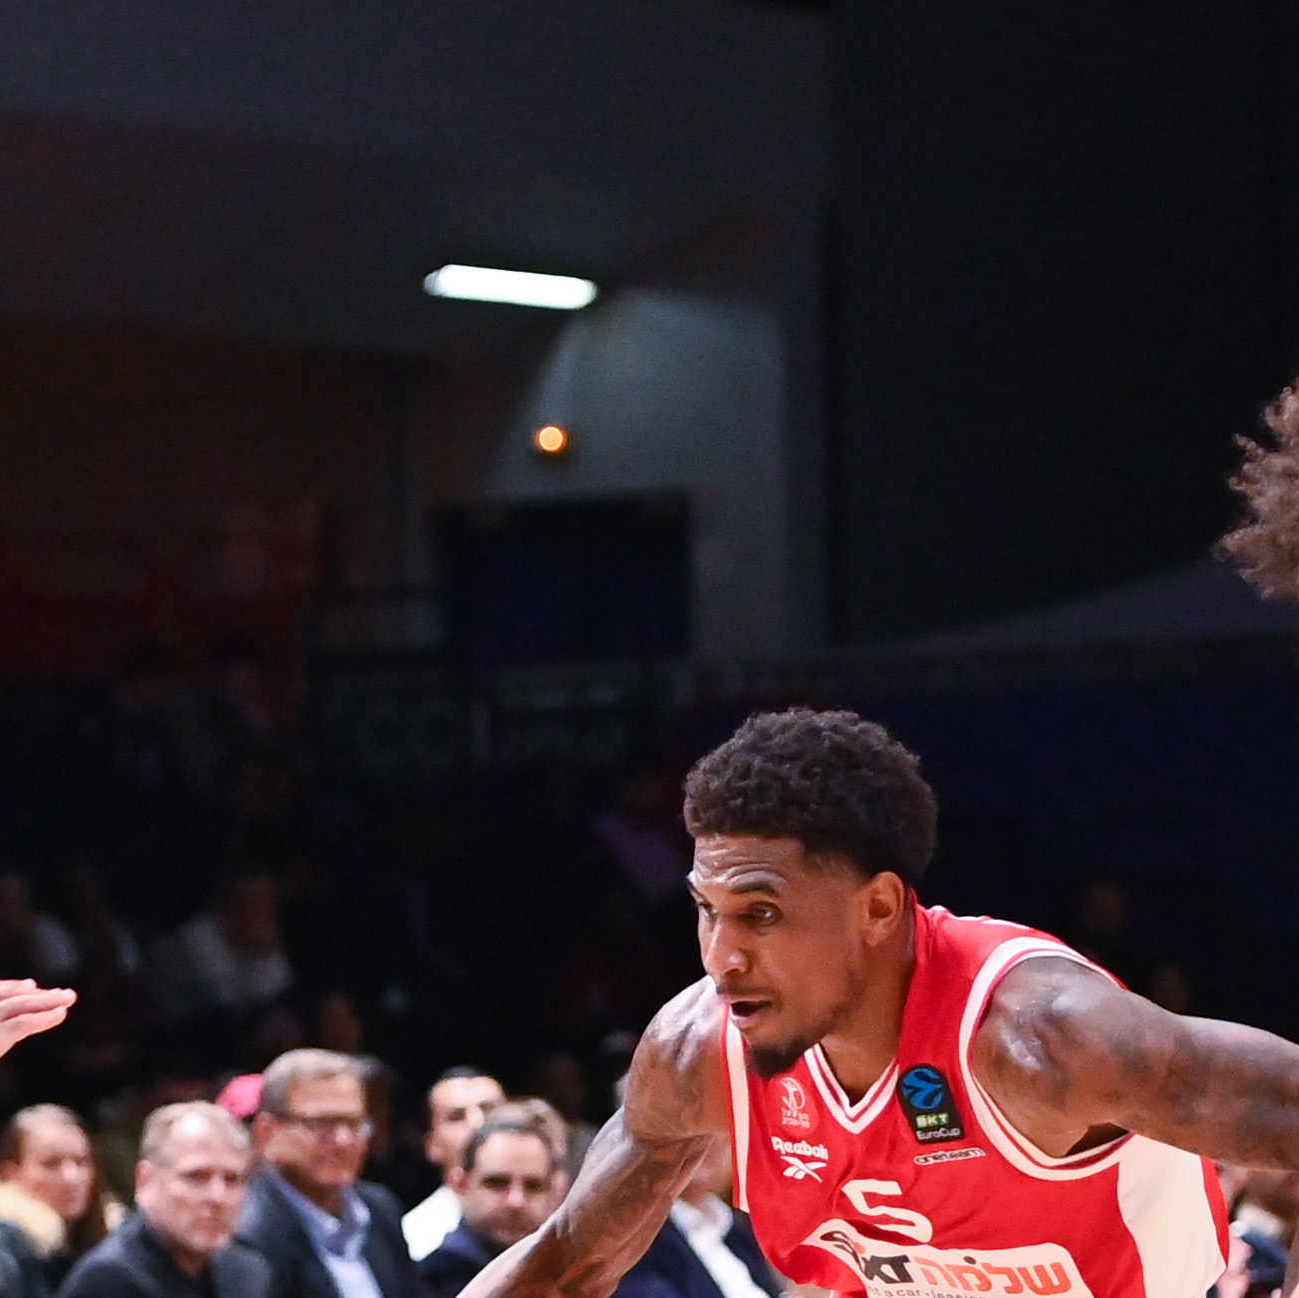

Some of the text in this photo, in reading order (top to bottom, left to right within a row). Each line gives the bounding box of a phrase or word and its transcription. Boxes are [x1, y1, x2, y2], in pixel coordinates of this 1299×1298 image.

[916, 1112, 949, 1129] BKT
[916, 1128, 961, 1140] EuroCup
[772, 1136, 829, 1161] Reebok
[841, 1179, 933, 1243] 5
[913, 1255, 1072, 1296] שלמה
[896, 1288, 921, 1297] car
